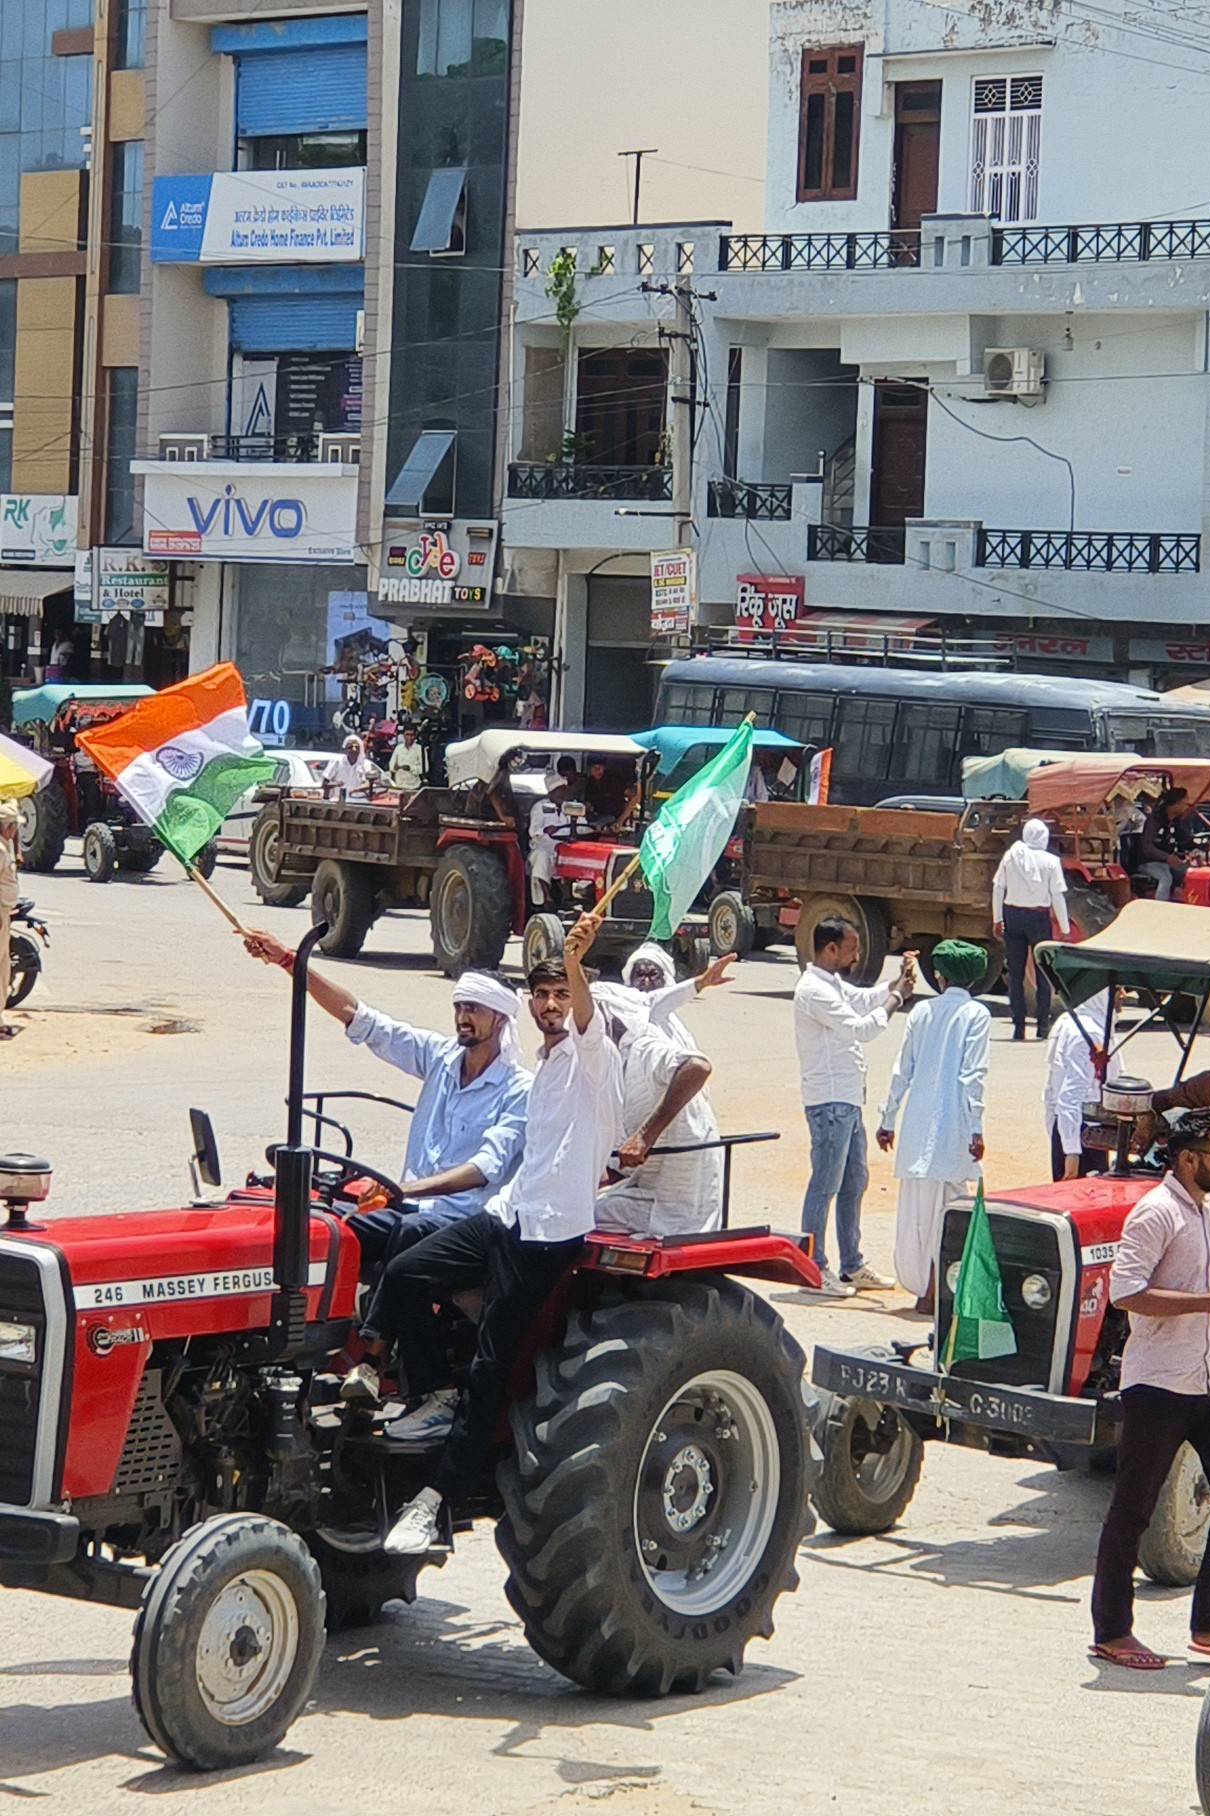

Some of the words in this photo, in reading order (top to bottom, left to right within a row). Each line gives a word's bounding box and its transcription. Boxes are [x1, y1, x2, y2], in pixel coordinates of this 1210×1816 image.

[180, 213, 203, 225] Credo
[231, 229, 249, 247] Altum
[250, 229, 268, 247] Credo
[270, 229, 288, 247] Home
[290, 228, 314, 247] Finance
[330, 226, 354, 247] Limited
[4, 499, 32, 530] RK
[187, 484, 307, 538] vivo
[102, 556, 146, 572] R.K.
[101, 574, 168, 586] Restaurant
[103, 589, 110, 598] &
[114, 588, 145, 598] Hotel
[378, 578, 455, 604] PRABHAT
[454, 587, 481, 601] TOYS
[768, 593, 797, 629] जूस
[1090, 1245, 1114, 1261] 1035
[94, 1287, 123, 1304] 246
[143, 1277, 206, 1299] MASSEY
[213, 1271, 273, 1291] FERGUS
